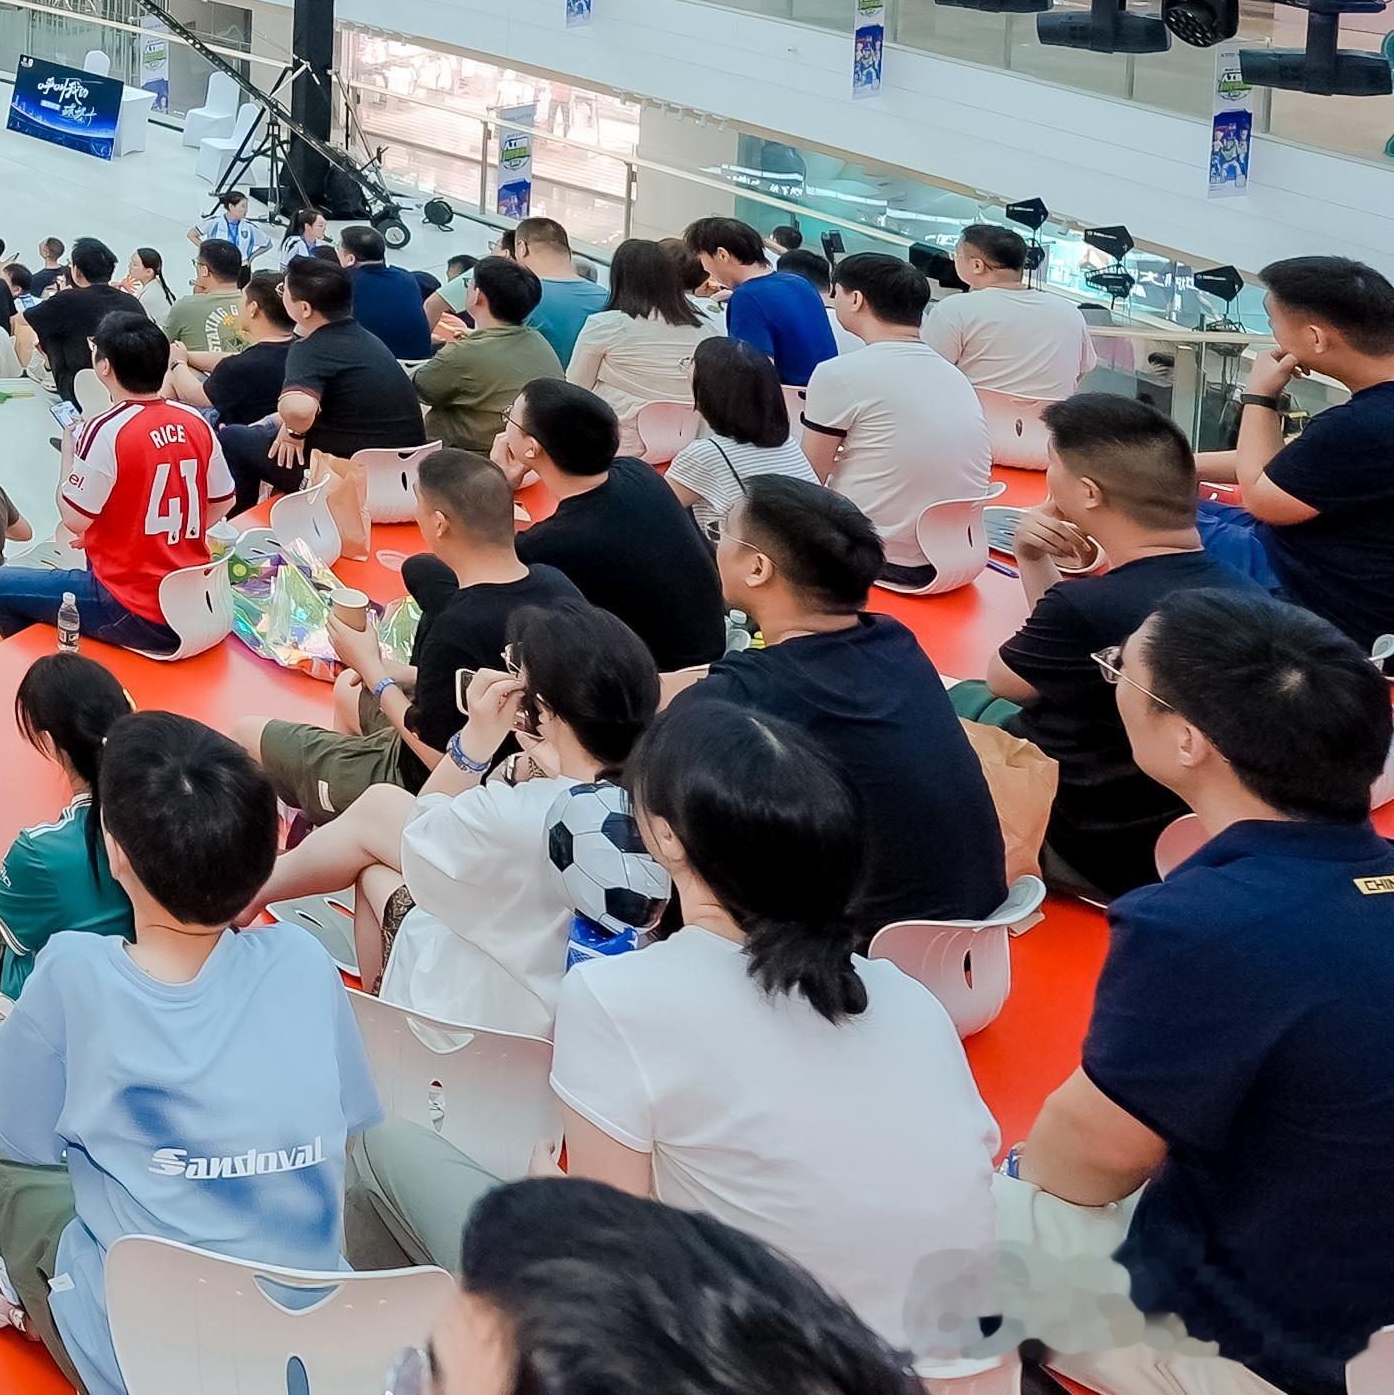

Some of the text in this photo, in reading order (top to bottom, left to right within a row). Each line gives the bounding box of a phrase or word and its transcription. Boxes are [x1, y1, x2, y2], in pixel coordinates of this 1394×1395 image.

[149, 424, 187, 450] RICE
[144, 458, 201, 546] 41
[147, 1135, 328, 1181] Sandoval
